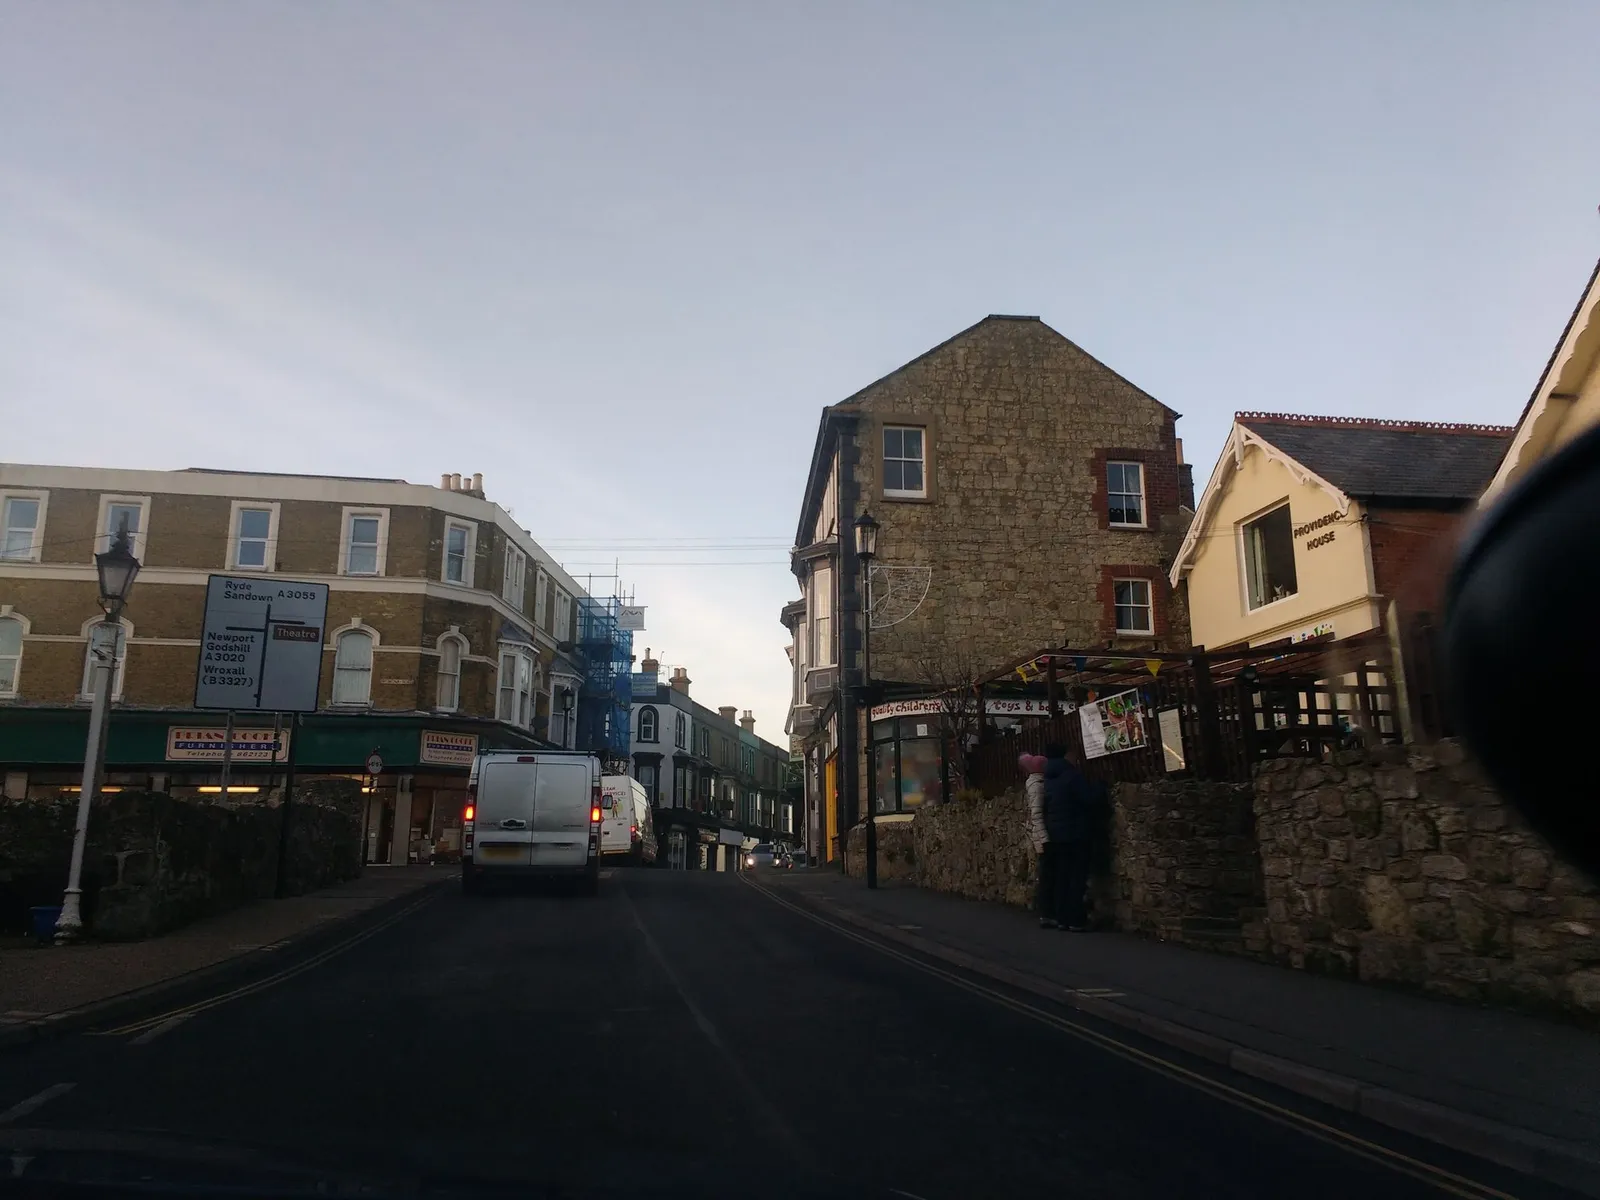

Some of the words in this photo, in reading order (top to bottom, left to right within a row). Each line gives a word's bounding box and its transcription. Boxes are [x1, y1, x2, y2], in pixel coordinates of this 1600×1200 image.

[1293, 510, 1342, 539] PROVIDENC
[1306, 530, 1336, 551] HOUSE
[225, 580, 252, 590] Ryde
[224, 591, 273, 602] Sandown
[278, 590, 316, 601] A3055
[207, 632, 255, 643] Newport
[277, 628, 316, 639] Theatre
[206, 643, 250, 653] Godshill
[204, 653, 246, 663] A3020
[204, 665, 245, 676] Wroxall
[202, 676, 254, 687] (B3327)
[872, 703, 894, 718] quality
[993, 700, 1020, 712] toys
